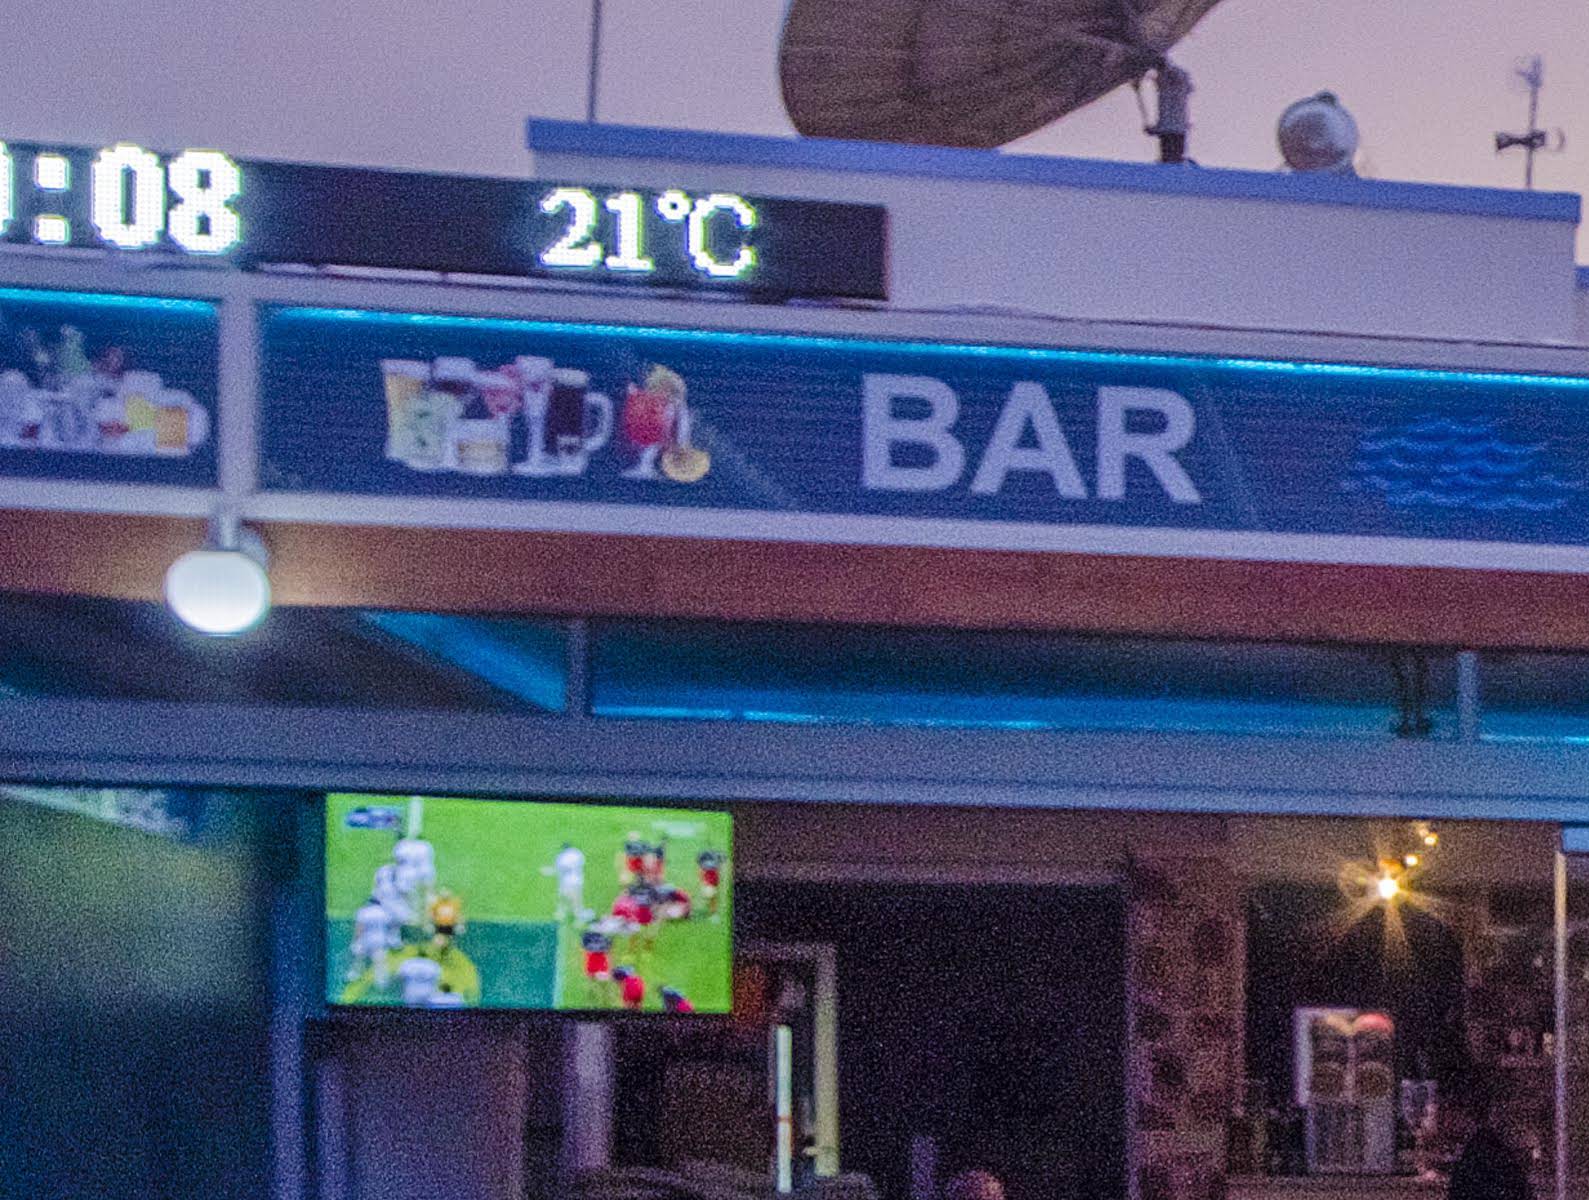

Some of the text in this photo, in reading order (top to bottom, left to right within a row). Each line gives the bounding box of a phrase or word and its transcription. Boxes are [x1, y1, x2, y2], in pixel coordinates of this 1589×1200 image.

[0, 140, 242, 255] :08
[536, 184, 758, 278] 21°C
[861, 371, 1202, 505] BAR
